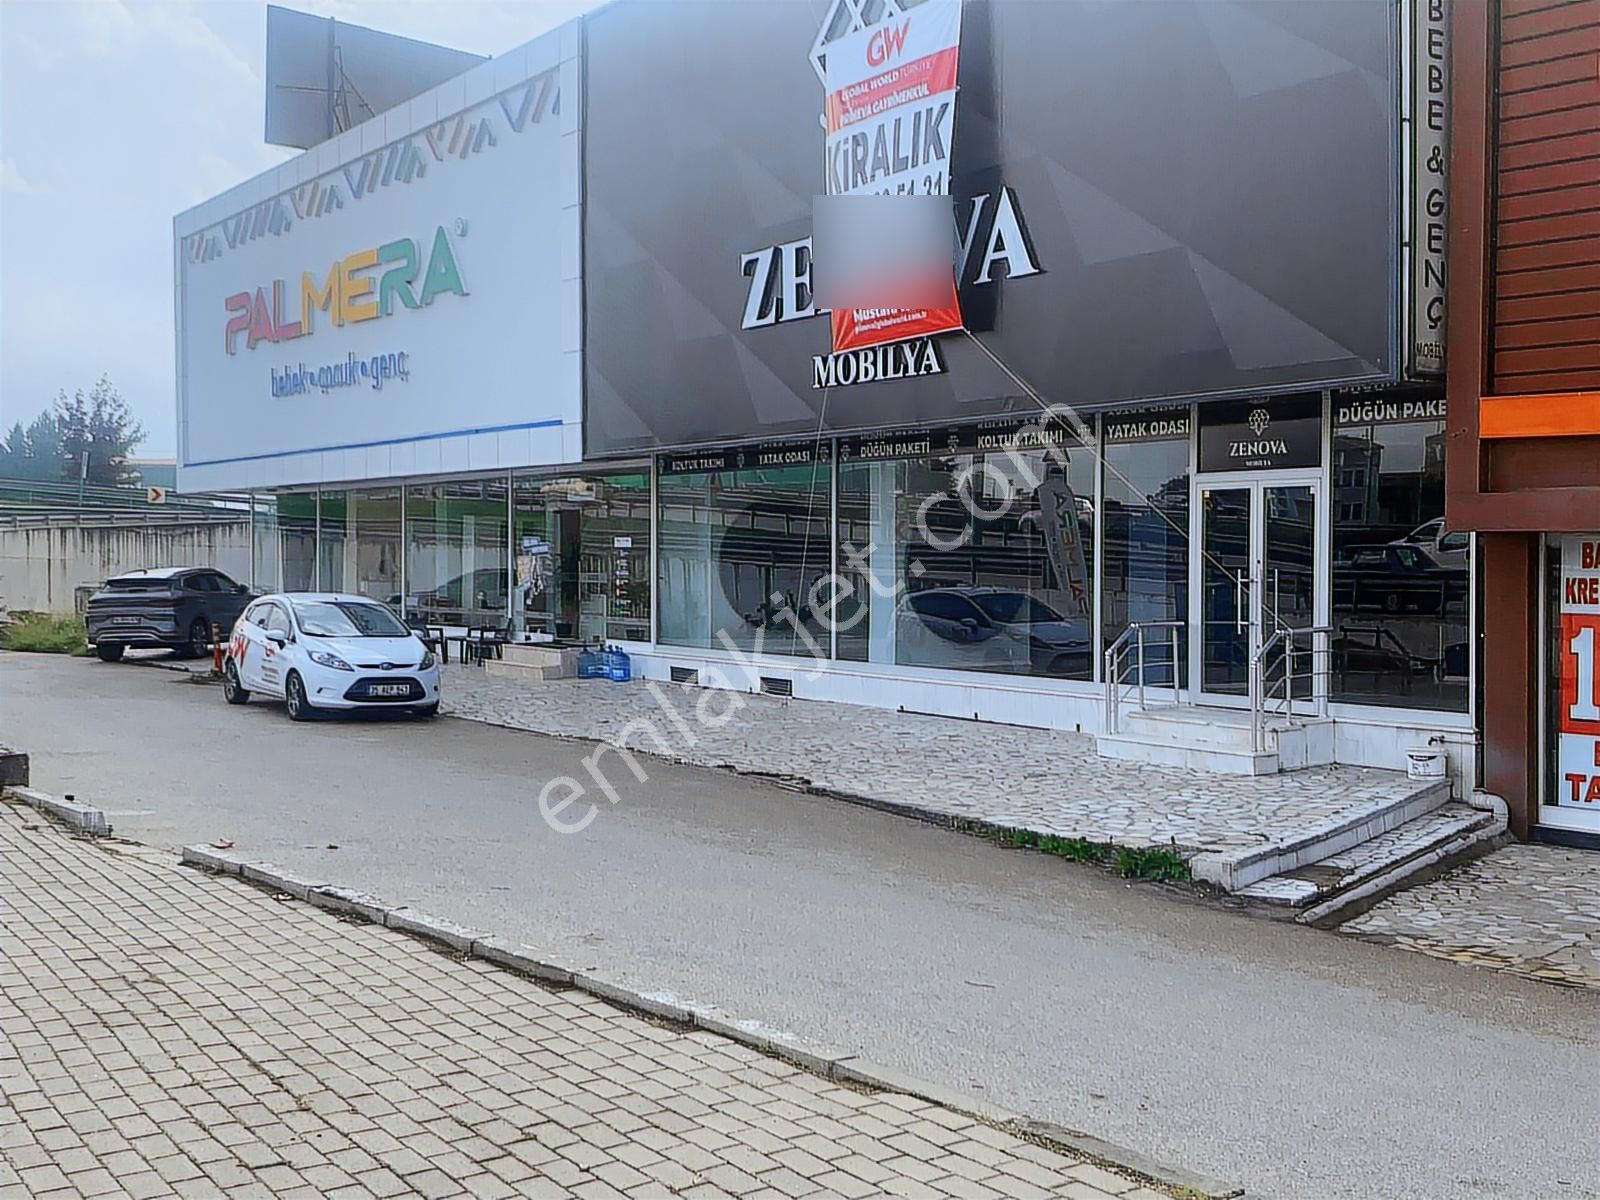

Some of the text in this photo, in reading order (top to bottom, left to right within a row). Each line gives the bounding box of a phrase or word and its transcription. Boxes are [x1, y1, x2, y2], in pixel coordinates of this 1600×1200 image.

[866, 17, 911, 67] GW
[828, 102, 950, 195] KİRALIK
[1424, 0, 1446, 330] BEBE & GENÇ
[741, 186, 1041, 330] ZEVA
[225, 225, 468, 356] PALMERA
[1339, 400, 1397, 423] DÜĞÜN
[977, 433, 1020, 449] KOLTUK
[1107, 418, 1189, 439] YATAK ODASI
[860, 436, 930, 458] DÜĞÜN PAKETİ
[1229, 440, 1287, 457] ZENOVA
[1565, 576, 1599, 605] KRE
